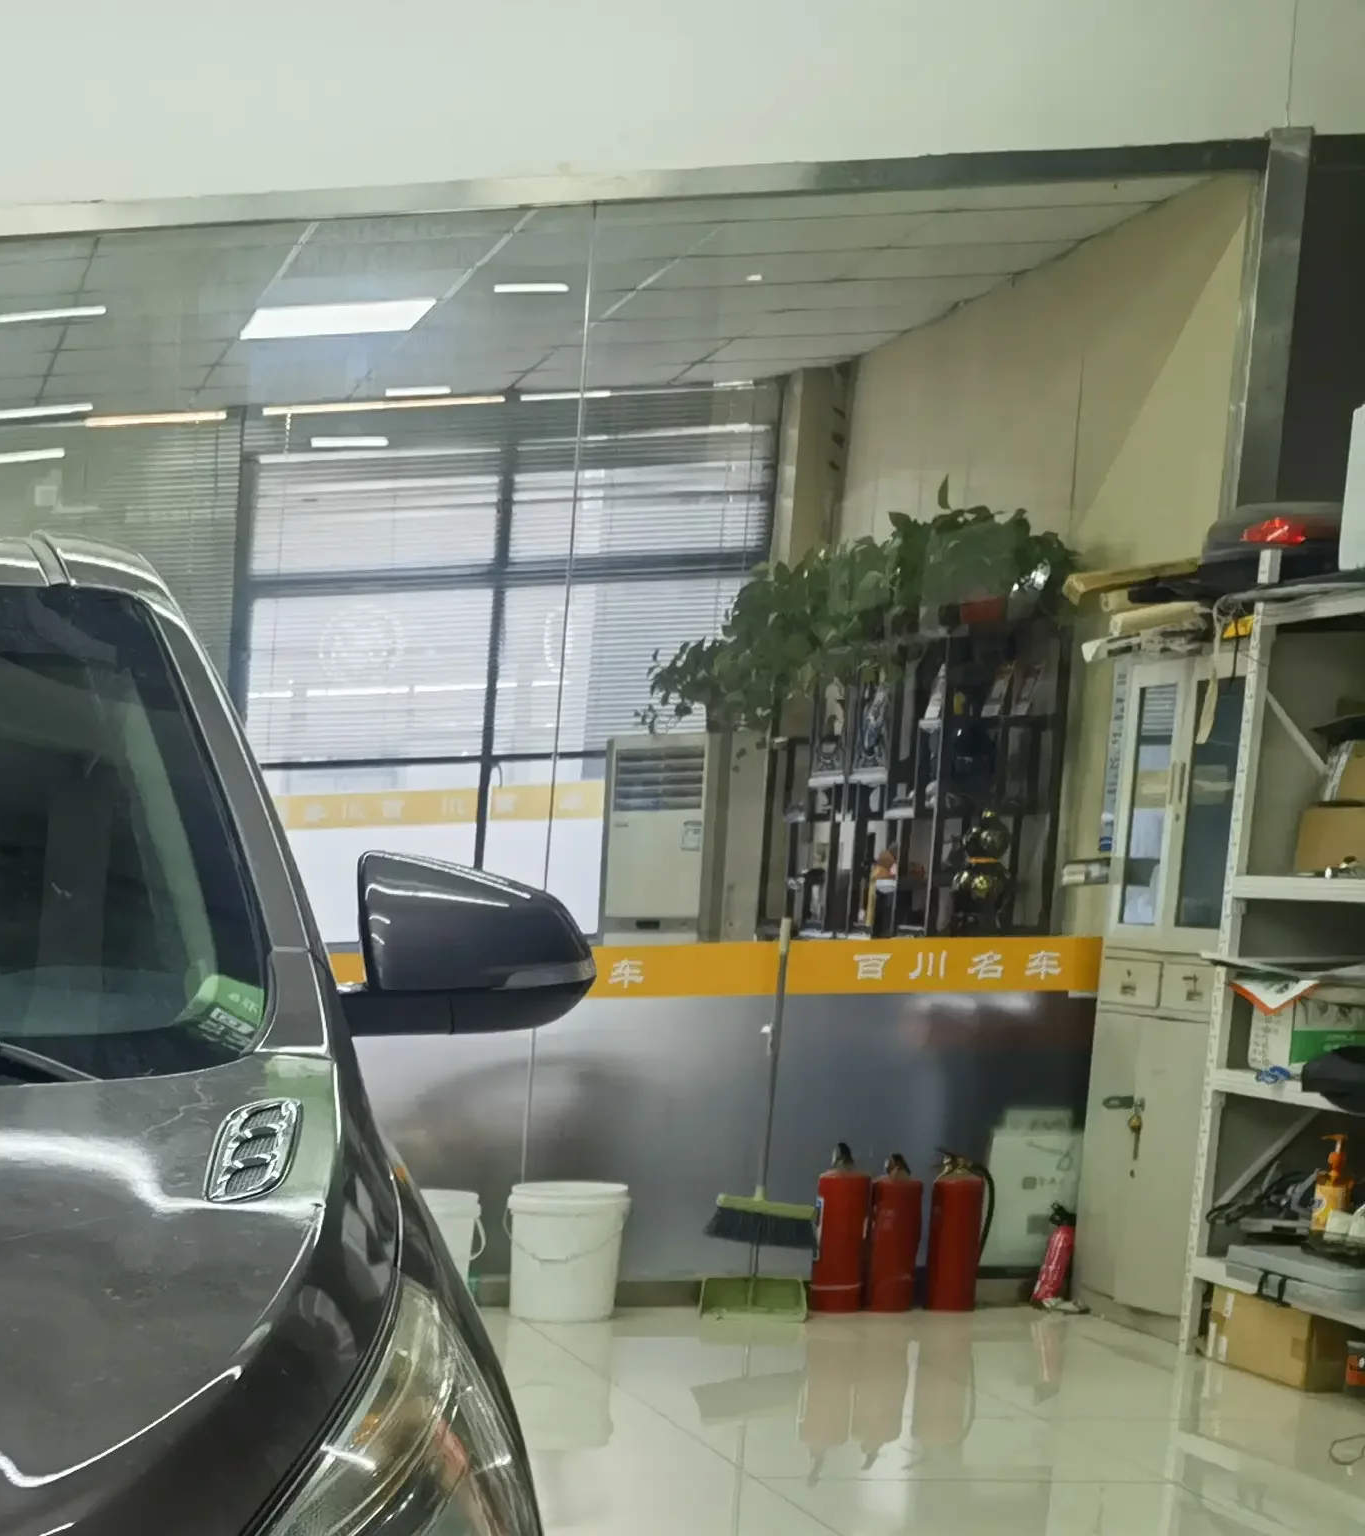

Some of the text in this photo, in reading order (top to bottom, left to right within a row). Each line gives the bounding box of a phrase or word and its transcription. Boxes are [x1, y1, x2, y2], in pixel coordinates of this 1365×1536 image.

[609, 959, 645, 988] 车
[853, 950, 1063, 982] 百川名车
